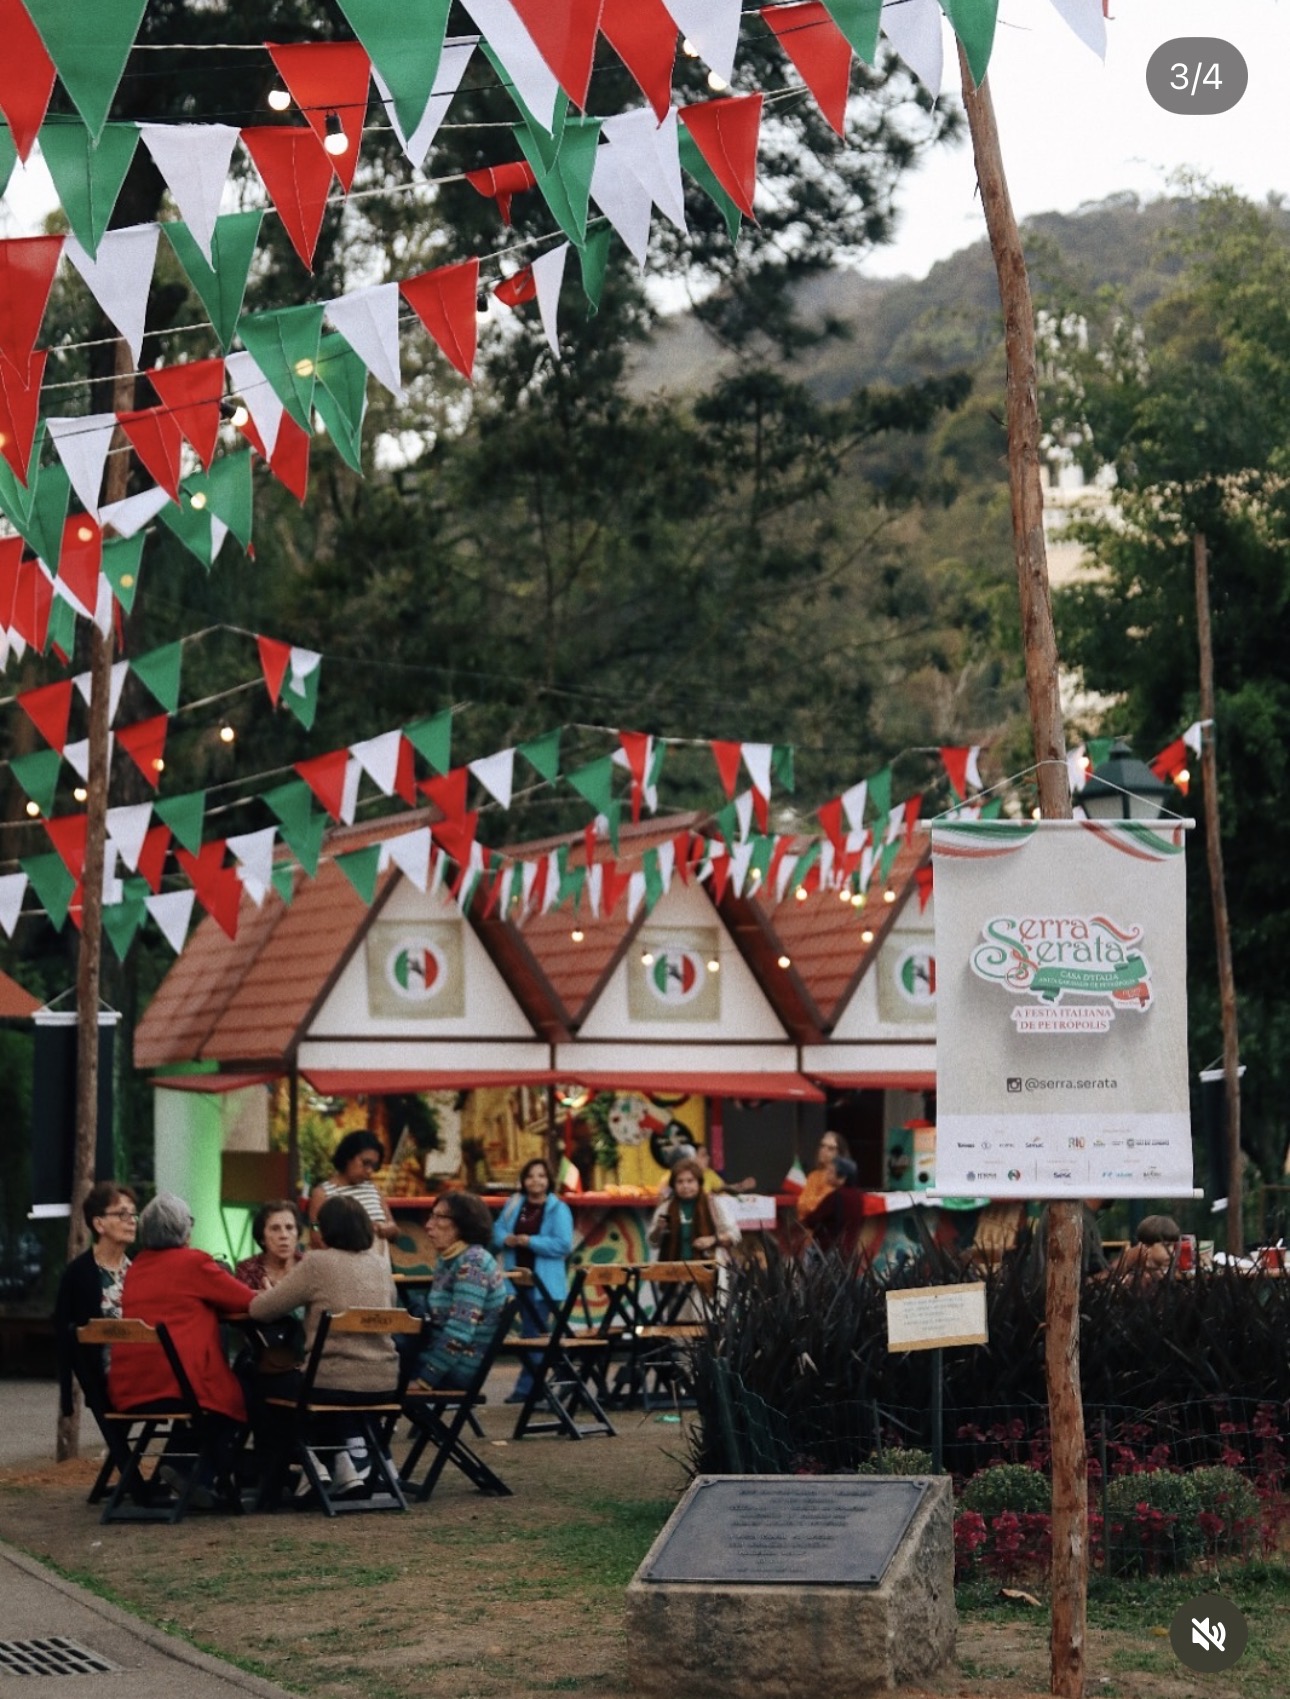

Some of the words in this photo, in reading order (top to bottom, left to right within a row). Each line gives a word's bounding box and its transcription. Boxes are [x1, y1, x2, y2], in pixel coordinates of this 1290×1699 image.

[1005, 934, 1125, 989] Serata
[1060, 970, 1081, 981] CASA
[1015, 1008, 1023, 1018] A
[1025, 1008, 1058, 1018] FESTA
[1060, 1008, 1112, 1018] ITALIANA
[1020, 1020, 1036, 1030] DE
[1024, 1077, 1118, 1092] @serra.serata
